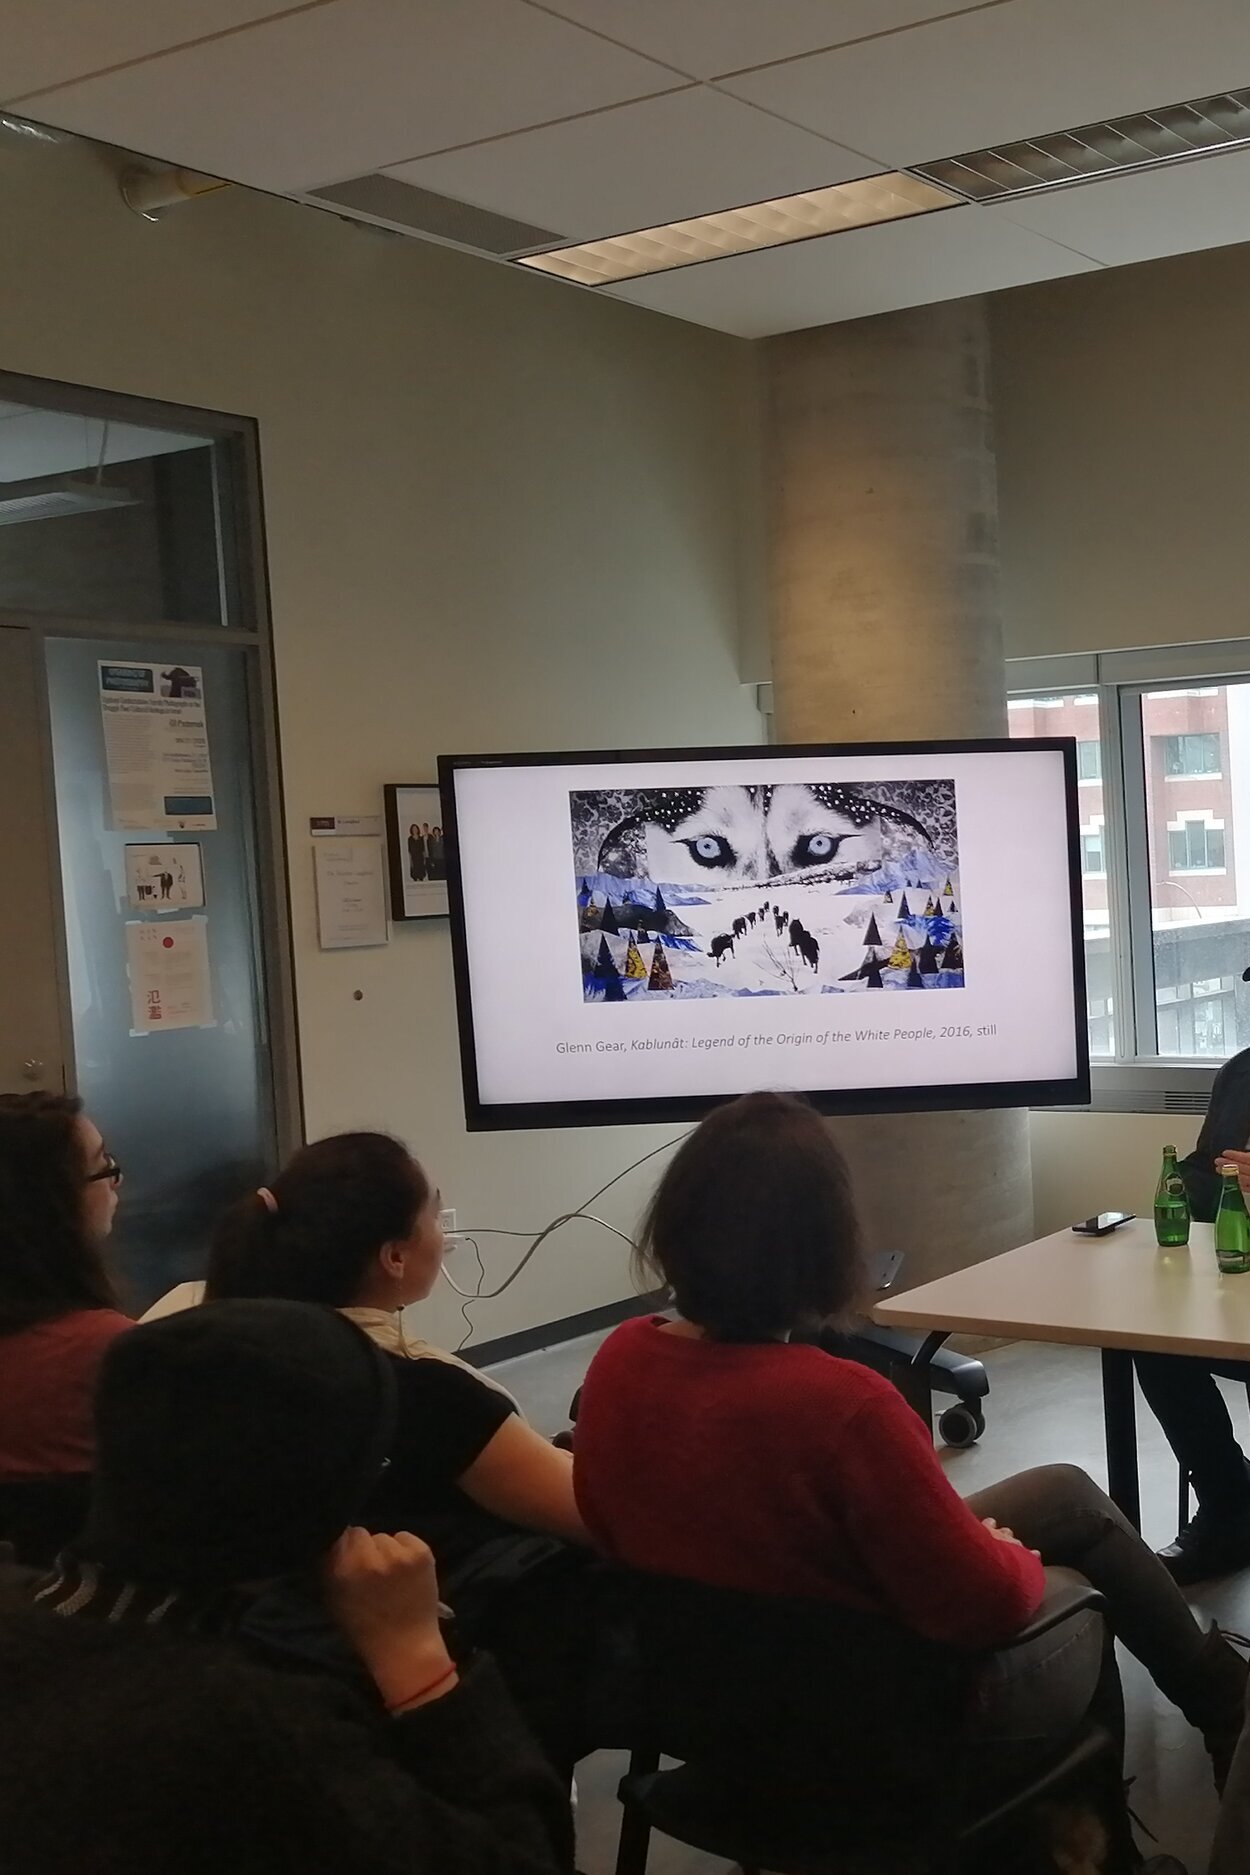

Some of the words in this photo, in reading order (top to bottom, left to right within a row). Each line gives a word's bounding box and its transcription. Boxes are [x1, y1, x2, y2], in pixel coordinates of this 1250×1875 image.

[556, 1042, 592, 1054] Glenn
[596, 1041, 627, 1053] Gear,
[692, 1035, 734, 1050] Legend
[738, 1034, 752, 1048] of
[754, 1034, 773, 1046] the
[777, 1032, 812, 1046] Origin
[816, 1031, 830, 1045] of
[832, 1031, 851, 1042] the
[855, 1029, 890, 1041] White
[894, 1028, 936, 1041] People,
[940, 1026, 973, 1038] 2016,
[977, 1024, 997, 1036] still
